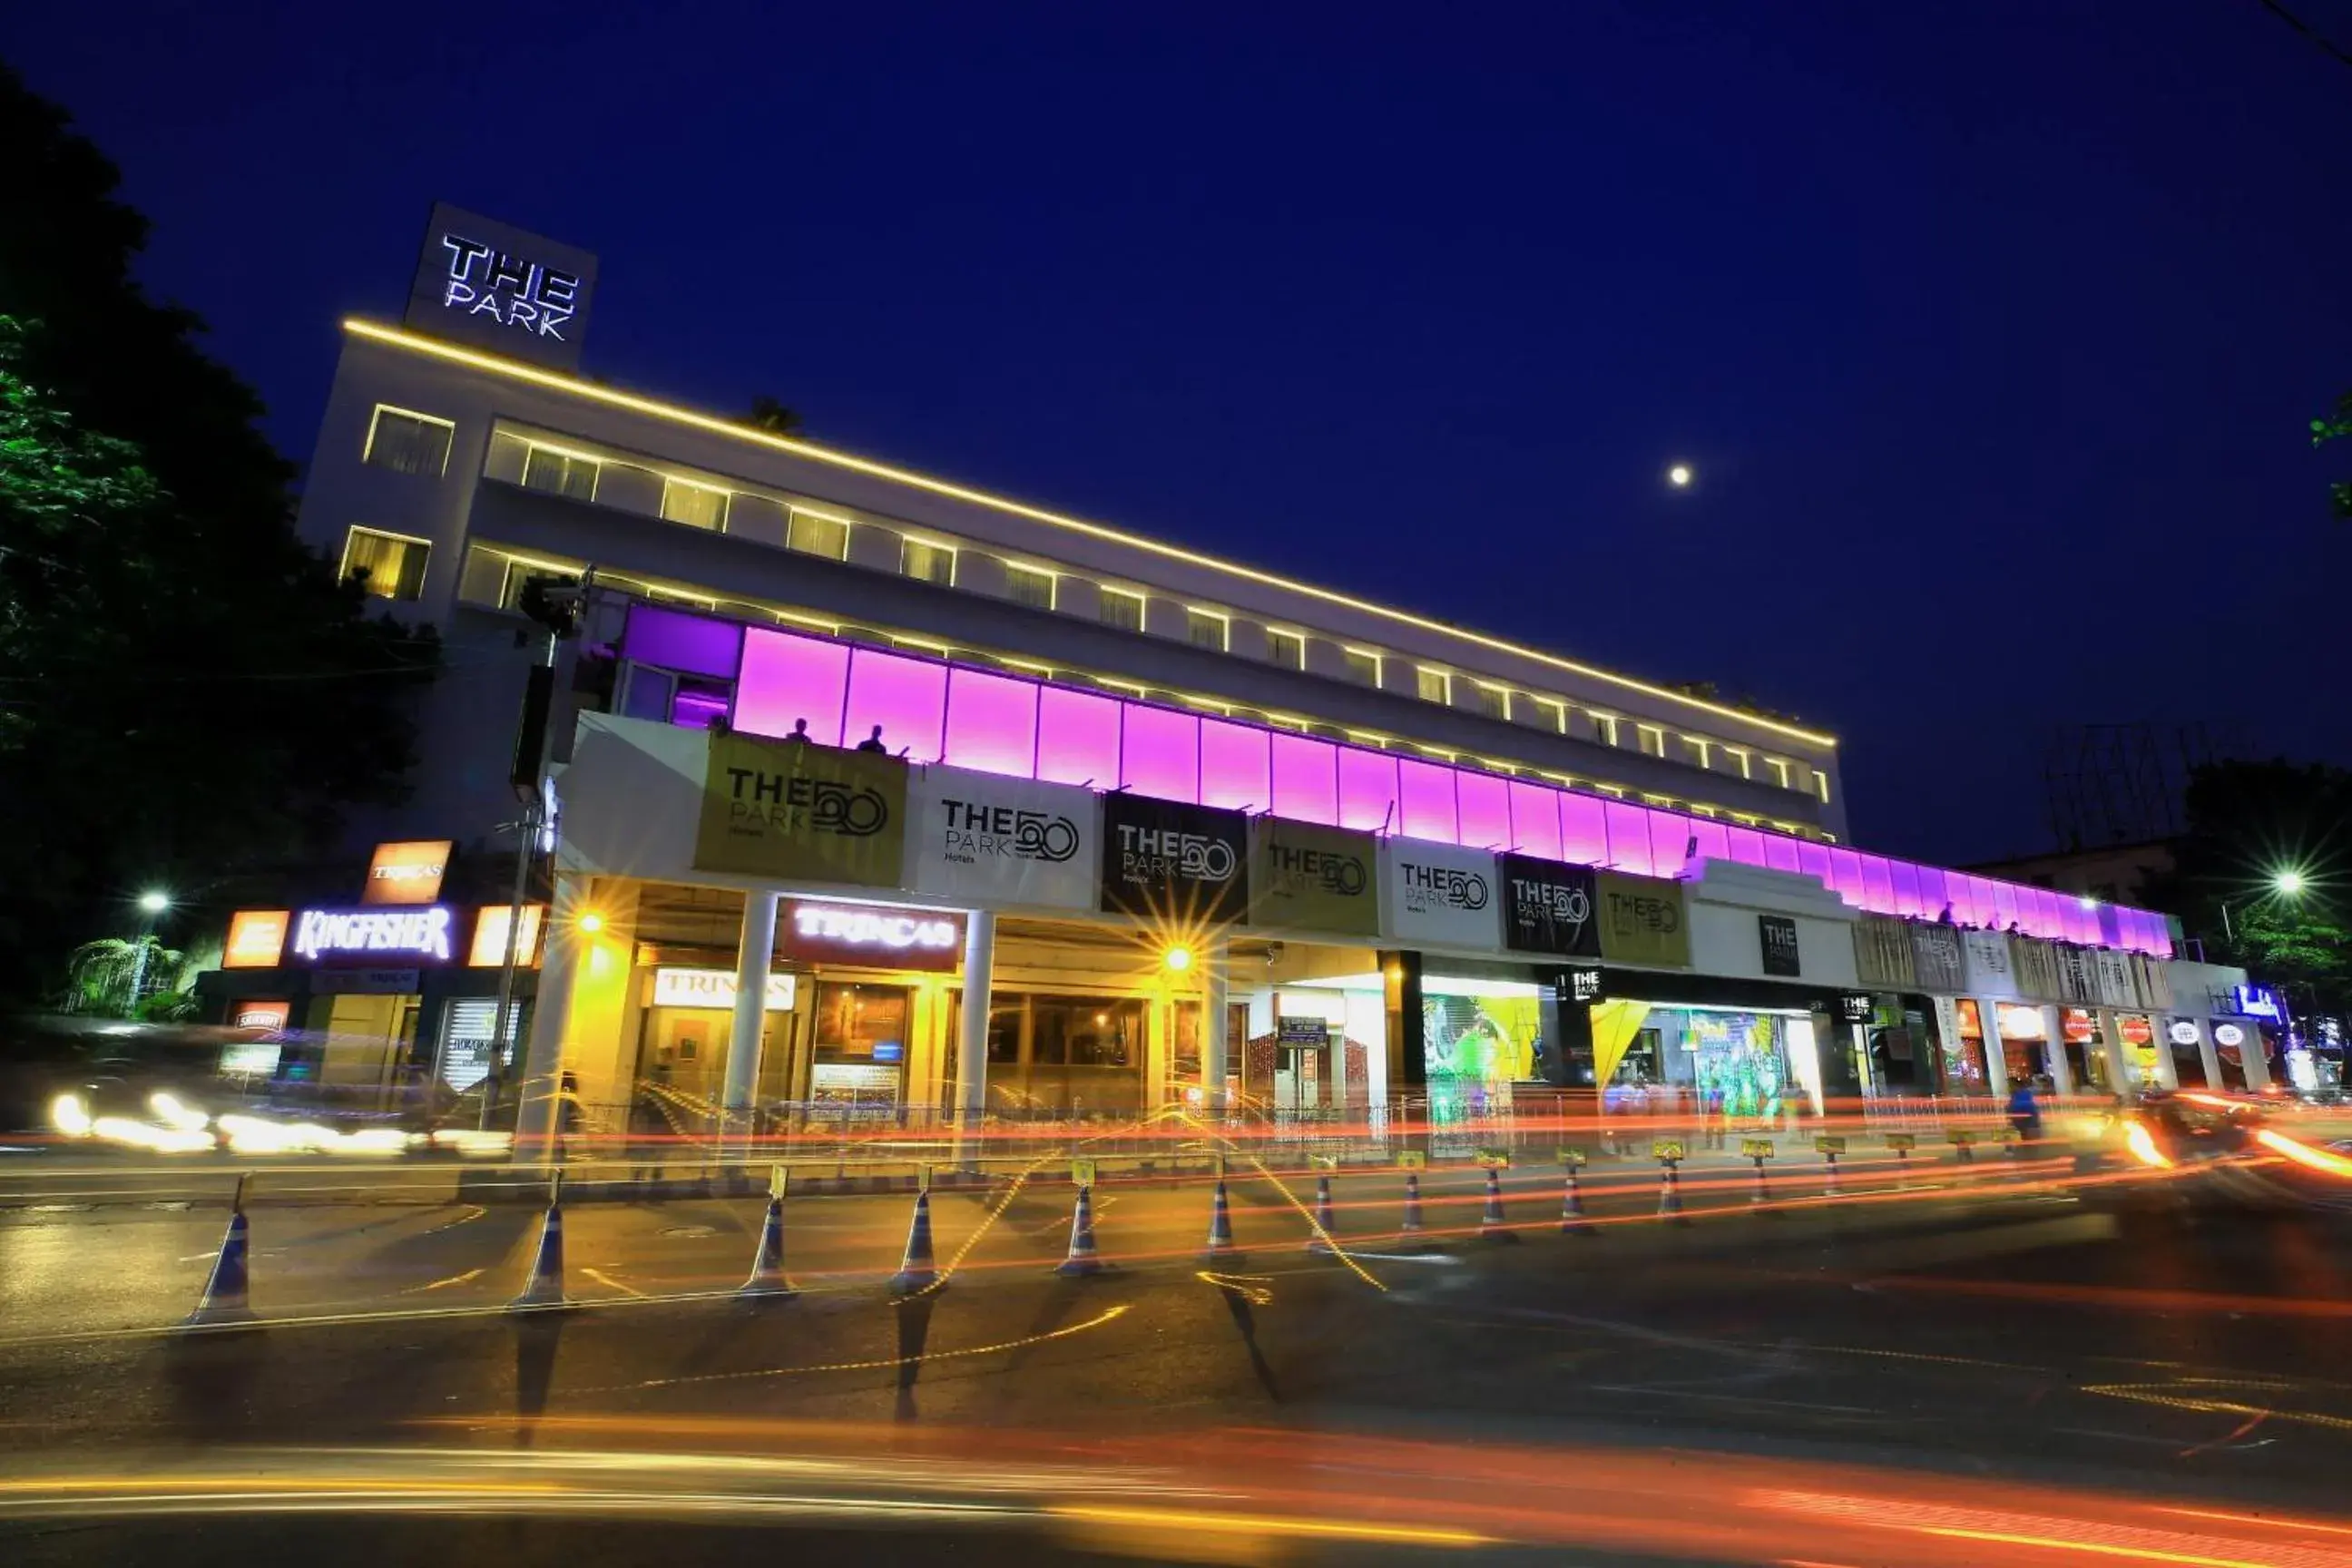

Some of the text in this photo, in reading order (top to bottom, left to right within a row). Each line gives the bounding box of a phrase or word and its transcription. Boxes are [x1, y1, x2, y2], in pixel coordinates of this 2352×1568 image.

[443, 232, 579, 314] THE
[446, 280, 570, 341] PARK
[727, 767, 811, 807] THE
[730, 801, 803, 829] PARK
[941, 799, 1014, 835] THE
[946, 830, 1011, 858] PARK
[1014, 810, 1080, 862] 50
[1118, 824, 1180, 857] THE
[1122, 853, 1179, 877] PARK
[1269, 844, 1318, 873] THE
[1400, 863, 1447, 889] THE
[1512, 879, 1553, 904] THE
[295, 908, 450, 959] KINGFISHER
[794, 907, 956, 947] TRINCAS
[1764, 925, 1797, 946] THE
[1573, 972, 1600, 985] THE
[1842, 996, 1870, 1008] THE
